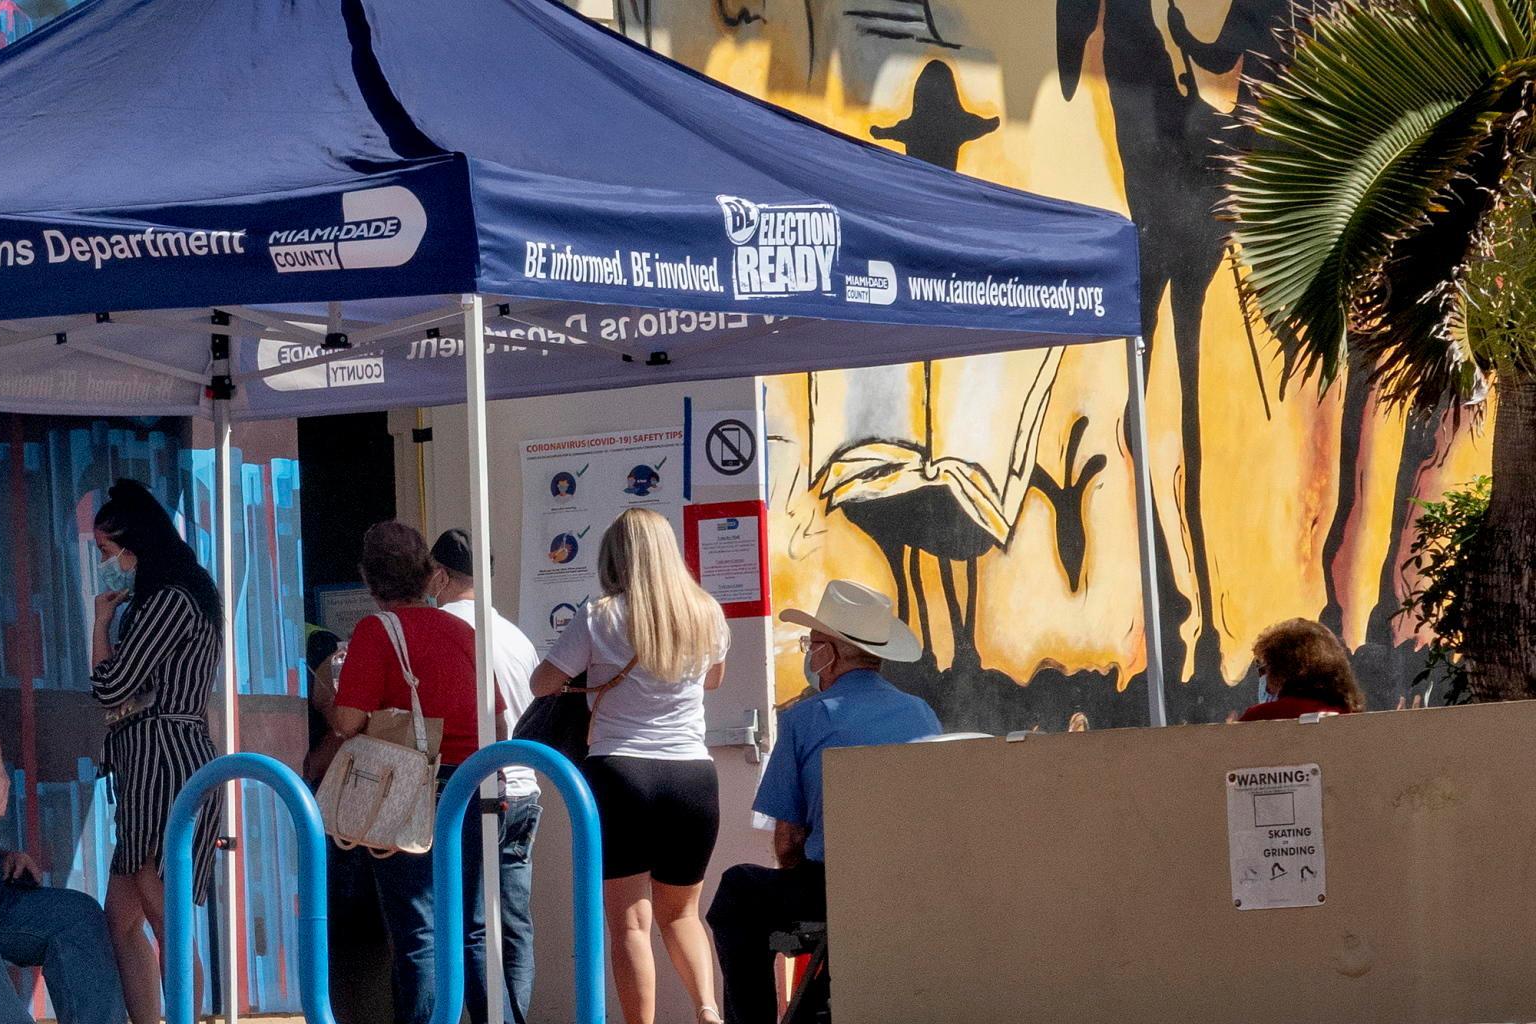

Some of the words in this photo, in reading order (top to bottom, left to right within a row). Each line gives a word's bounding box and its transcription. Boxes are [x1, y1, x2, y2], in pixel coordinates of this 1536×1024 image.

[268, 219, 399, 244] MIAMI-DADE
[759, 211, 836, 246] ELECTION
[43, 227, 247, 270] Department
[274, 249, 333, 268] COUNTY
[525, 241, 547, 279] BE
[550, 243, 628, 286] informed.
[631, 251, 654, 285] BE
[655, 253, 725, 293] involved.
[737, 246, 836, 293] READY
[908, 272, 1106, 317] www.iamelectionready.org
[526, 438, 586, 454] CORONAVIRUS
[587, 435, 632, 449] (COVID-19)
[632, 432, 664, 444] SAFETY
[664, 430, 683, 441] TIPS
[1237, 770, 1310, 787] WARNING:
[1268, 827, 1312, 839] SKATING
[1263, 845, 1316, 858] GRINDING
